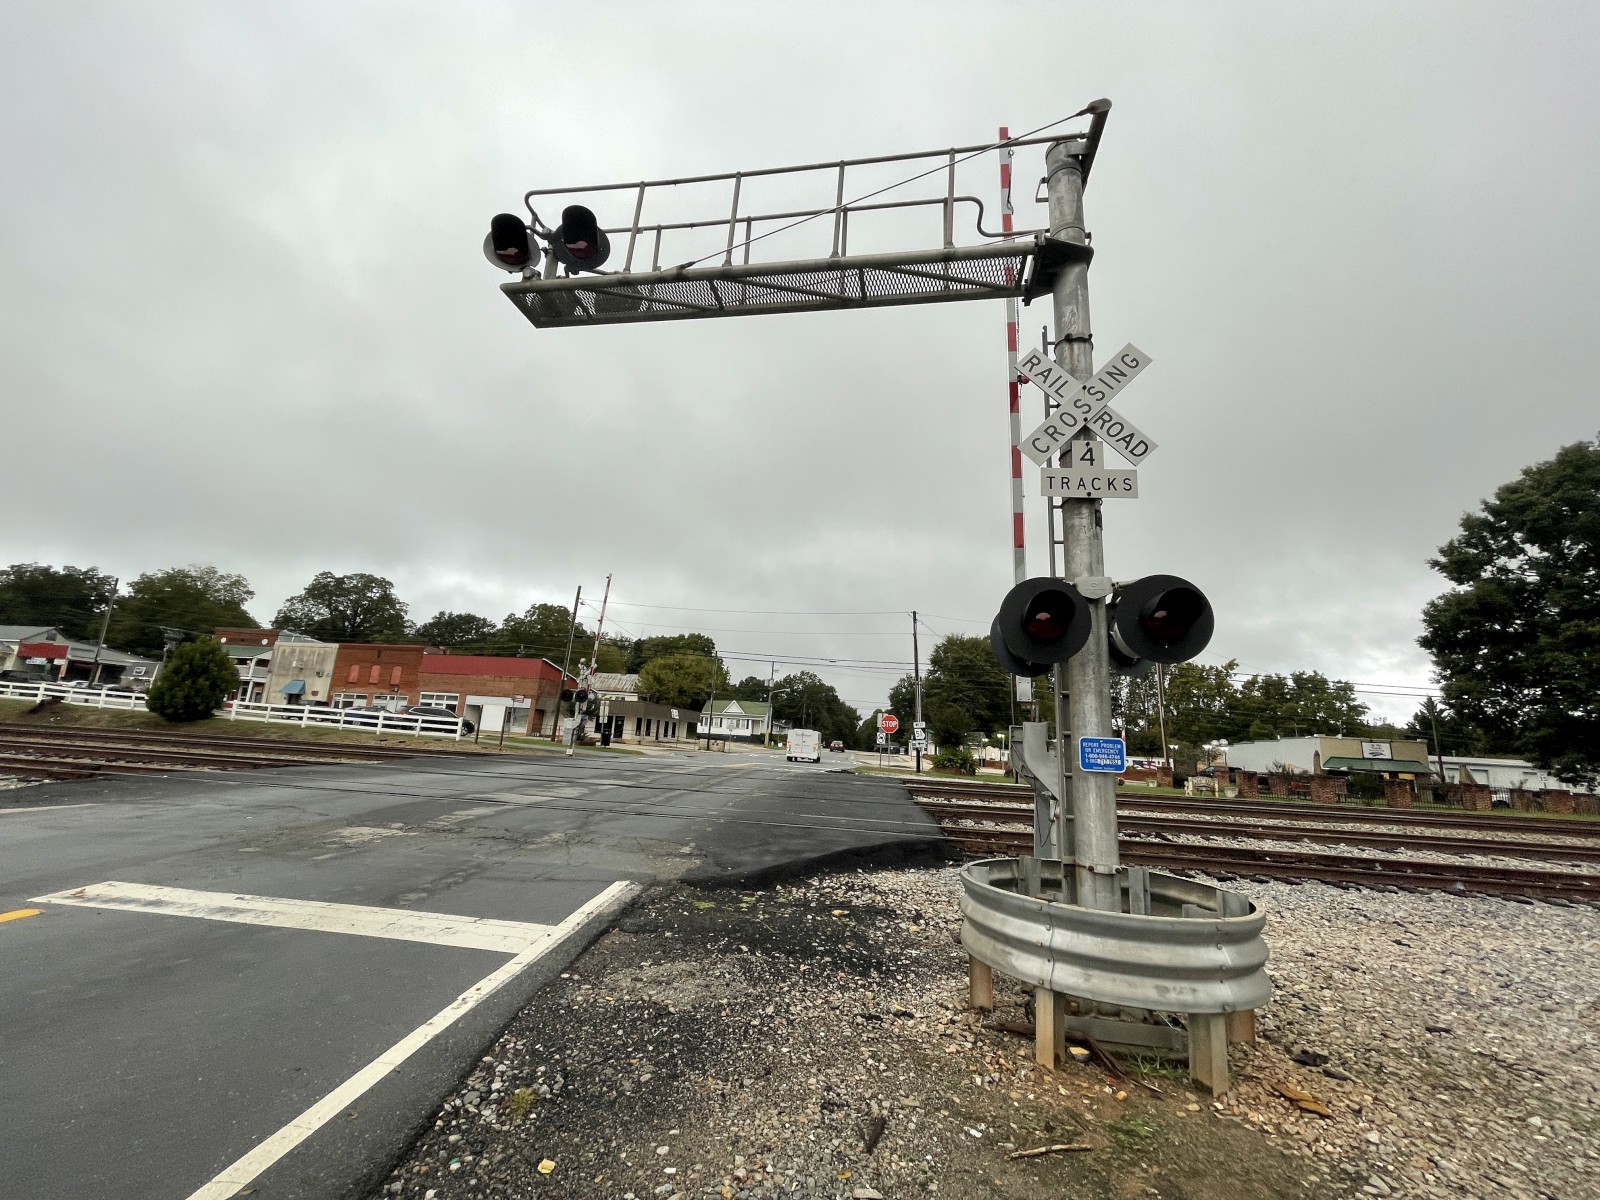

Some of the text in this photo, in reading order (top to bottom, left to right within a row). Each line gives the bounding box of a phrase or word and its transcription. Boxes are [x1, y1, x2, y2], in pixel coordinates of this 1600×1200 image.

[1022, 354, 1149, 457] RAIL ROAD
[1031, 353, 1140, 454] CROSSING
[1079, 447, 1096, 466] 4
[1046, 476, 1133, 491] TRACKS
[882, 720, 897, 728] STOP
